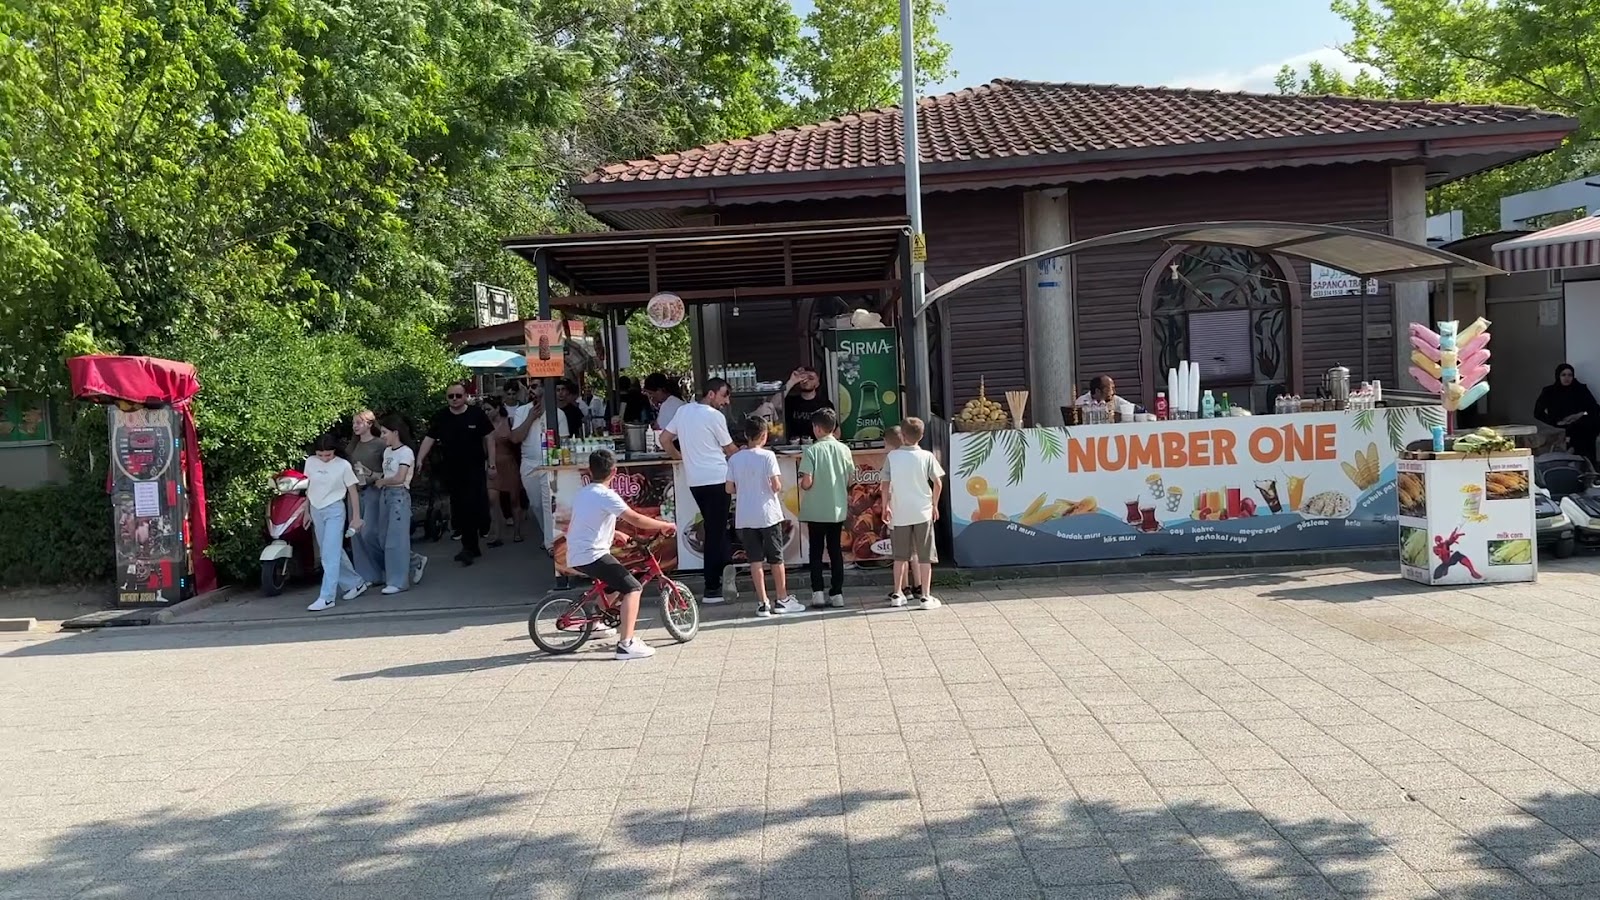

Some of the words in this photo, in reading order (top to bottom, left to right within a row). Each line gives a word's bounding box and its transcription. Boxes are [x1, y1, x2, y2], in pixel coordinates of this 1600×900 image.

[1312, 280, 1347, 290] SAPANCA
[1348, 278, 1377, 288] TRAEL
[1067, 428, 1238, 474] NUMBER
[1248, 423, 1338, 464] ONE
[1191, 526, 1214, 534] kahve
[1296, 519, 1330, 531] gözleme
[1056, 530, 1083, 540] bardak
[1169, 528, 1184, 536] çay
[1195, 533, 1229, 543] portakal
